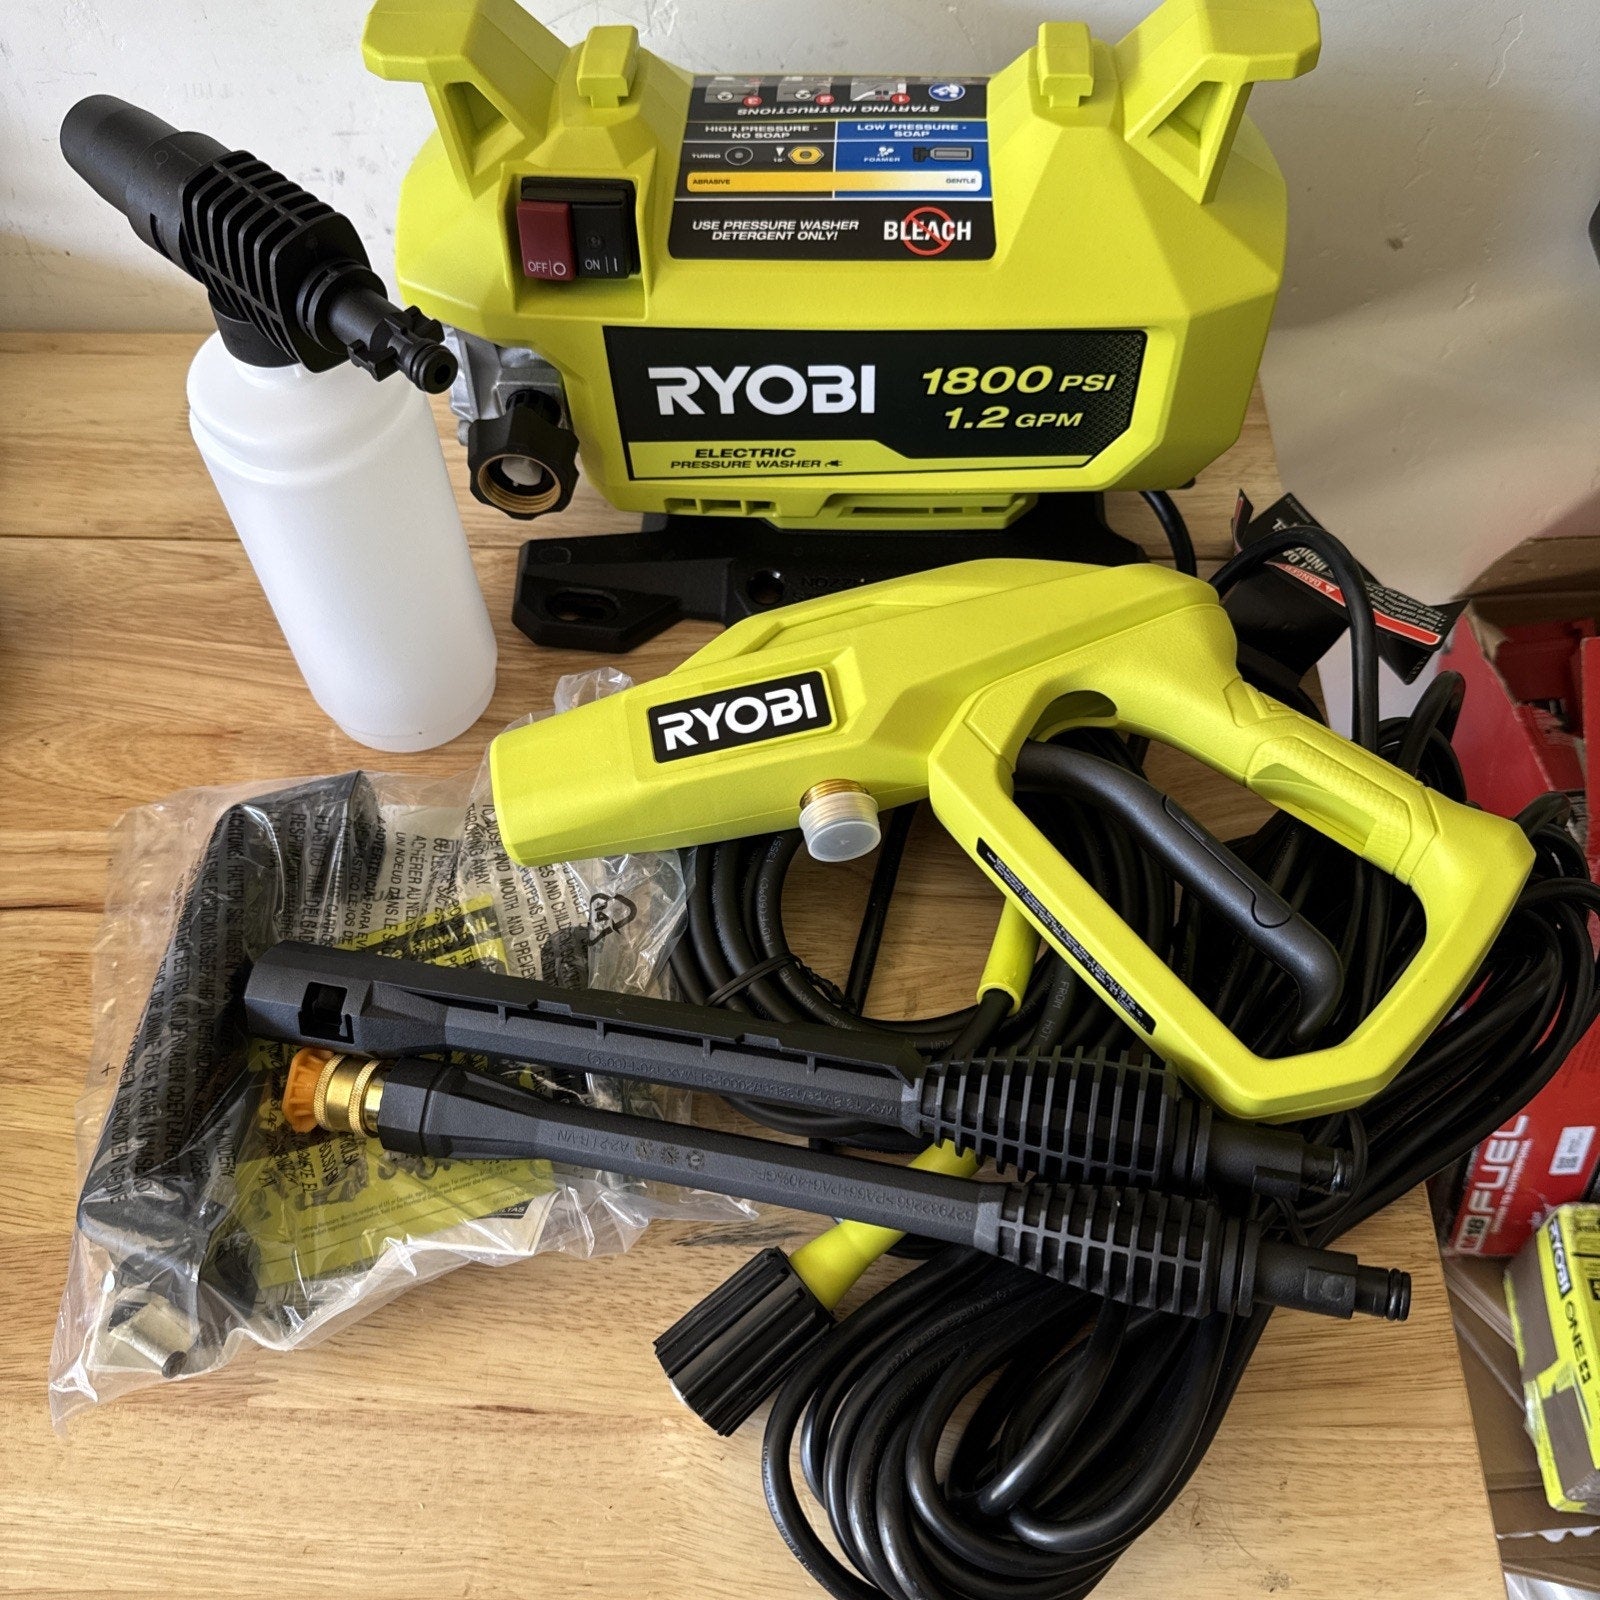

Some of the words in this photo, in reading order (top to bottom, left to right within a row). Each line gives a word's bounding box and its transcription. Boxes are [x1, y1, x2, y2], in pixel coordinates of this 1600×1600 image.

[737, 105, 855, 116] INSTRUCTIONS
[861, 105, 940, 113] STARTING
[692, 221, 720, 231] USE
[723, 221, 796, 231] PRESSURE
[800, 221, 859, 231] WASHER
[712, 231, 795, 241] DETERGENT
[797, 231, 839, 241] ONLY!
[884, 221, 972, 241] BLEACH
[585, 260, 600, 270] ON
[648, 365, 875, 415] RYOBI
[922, 365, 1053, 396] 1800
[1059, 374, 1116, 392] PSI
[944, 406, 1010, 429] 1.2
[1015, 413, 1083, 428] GPM
[695, 448, 796, 458] ELECTRIC
[670, 460, 750, 469] PRESSURE
[756, 460, 821, 468] WASHER
[1295, 546, 1327, 571] INDIV
[657, 683, 818, 752] RYOBI
[396, 831, 404, 845] UN
[391, 847, 404, 883] NOEUD
[471, 858, 490, 887] AWAY.
[494, 851, 509, 872] AND
[227, 866, 244, 902] HALTEN
[407, 884, 421, 899] AU
[500, 877, 519, 909] MOUTH
[543, 878, 562, 900] AND
[226, 909, 241, 925] SIE
[298, 900, 318, 942] DELGAD
[344, 894, 357, 926] LEJOS
[359, 903, 371, 929] PARA
[384, 918, 396, 929] LE
[508, 914, 524, 935] AND
[531, 917, 551, 942] THIS
[342, 930, 353, 945] DE
[150, 991, 163, 1008] DIE
[1051, 981, 1069, 1008] FROM
[168, 1001, 187, 1081] KINDERWAGEN
[1039, 1019, 1055, 1041] HOT
[168, 1086, 183, 1116] ODER
[1468, 1115, 1530, 1214] FUEL
